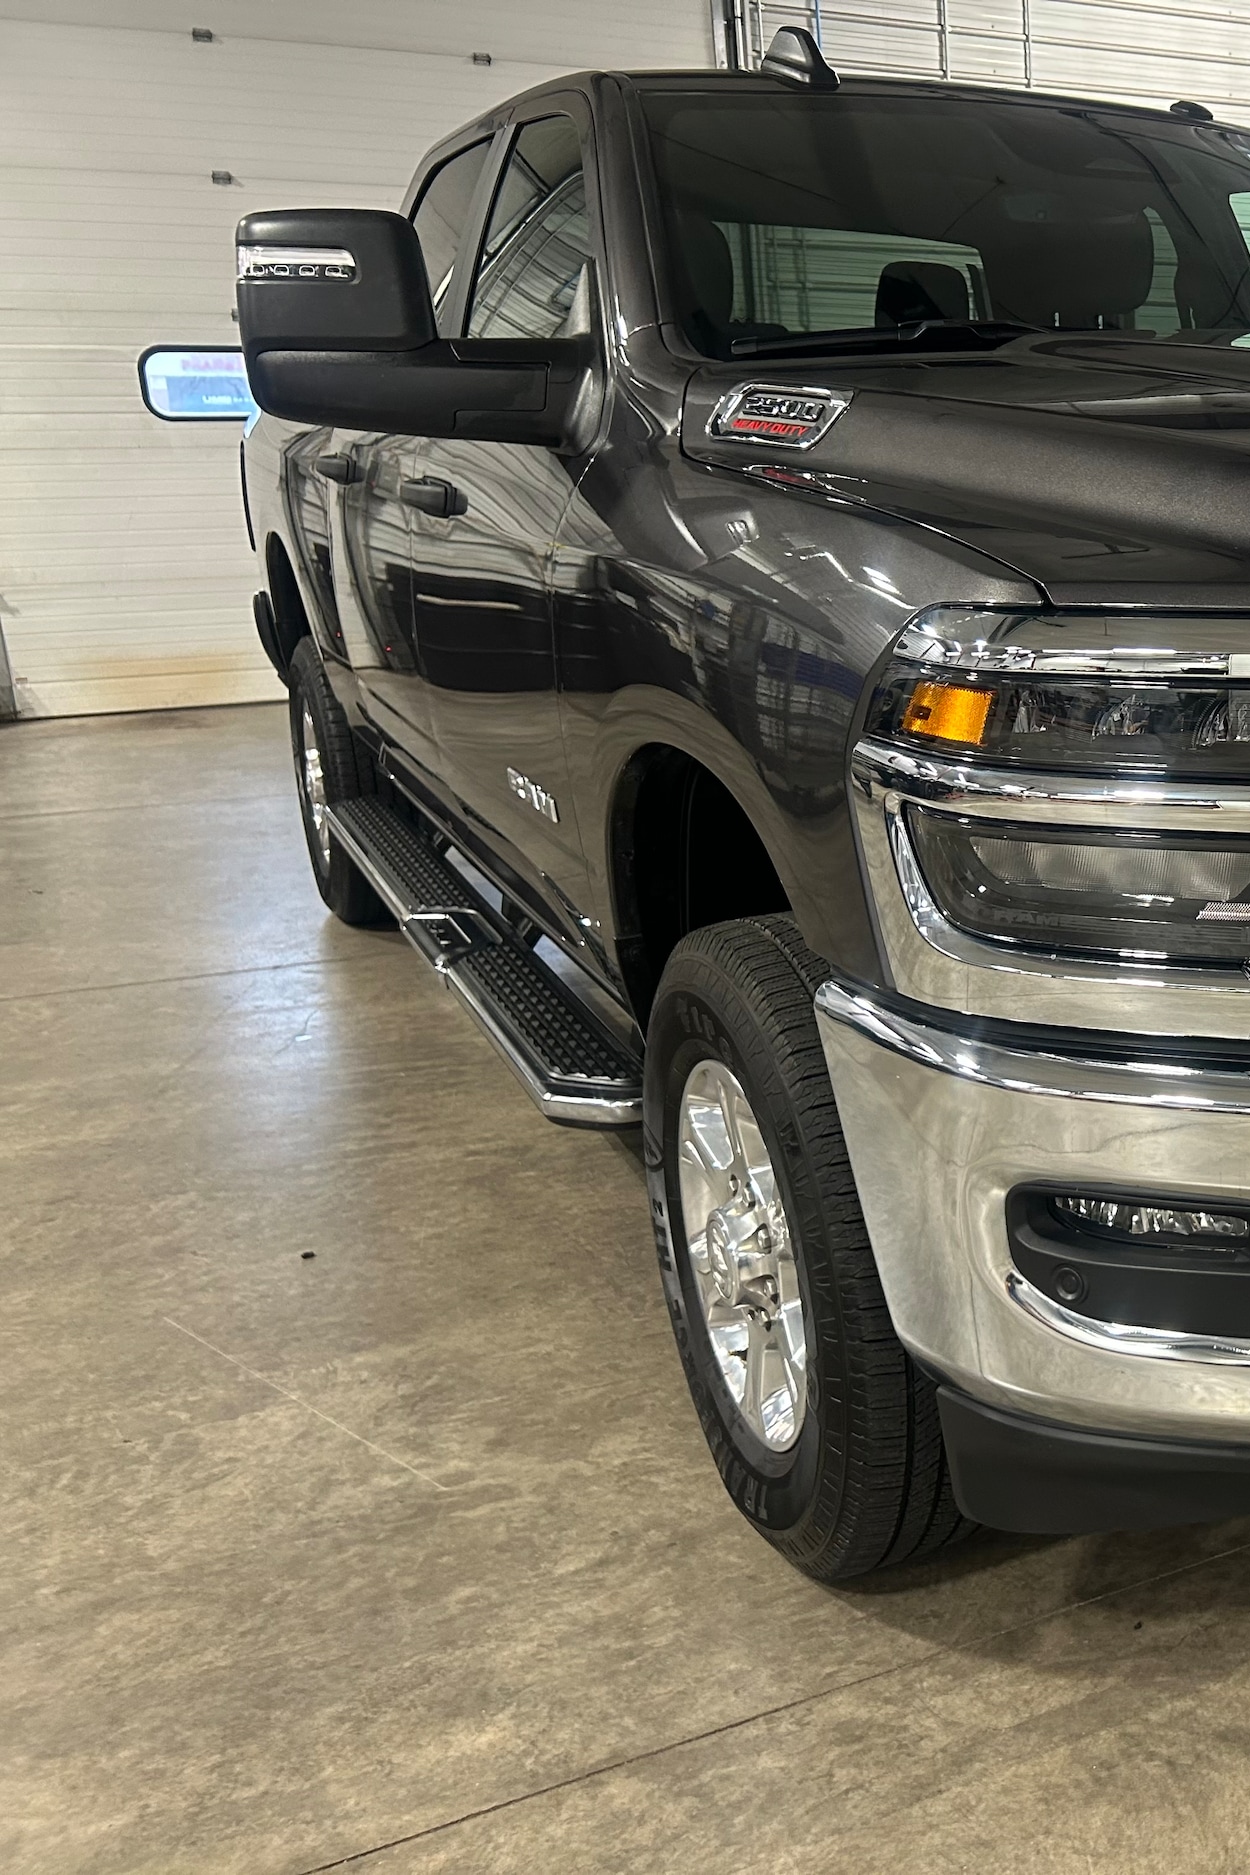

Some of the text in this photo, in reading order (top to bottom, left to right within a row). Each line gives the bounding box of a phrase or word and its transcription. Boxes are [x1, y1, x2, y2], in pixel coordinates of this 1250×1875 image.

[742, 396, 826, 422] 2500
[730, 418, 810, 437] HEAVY DUTY
[993, 909, 1060, 927] RAM
